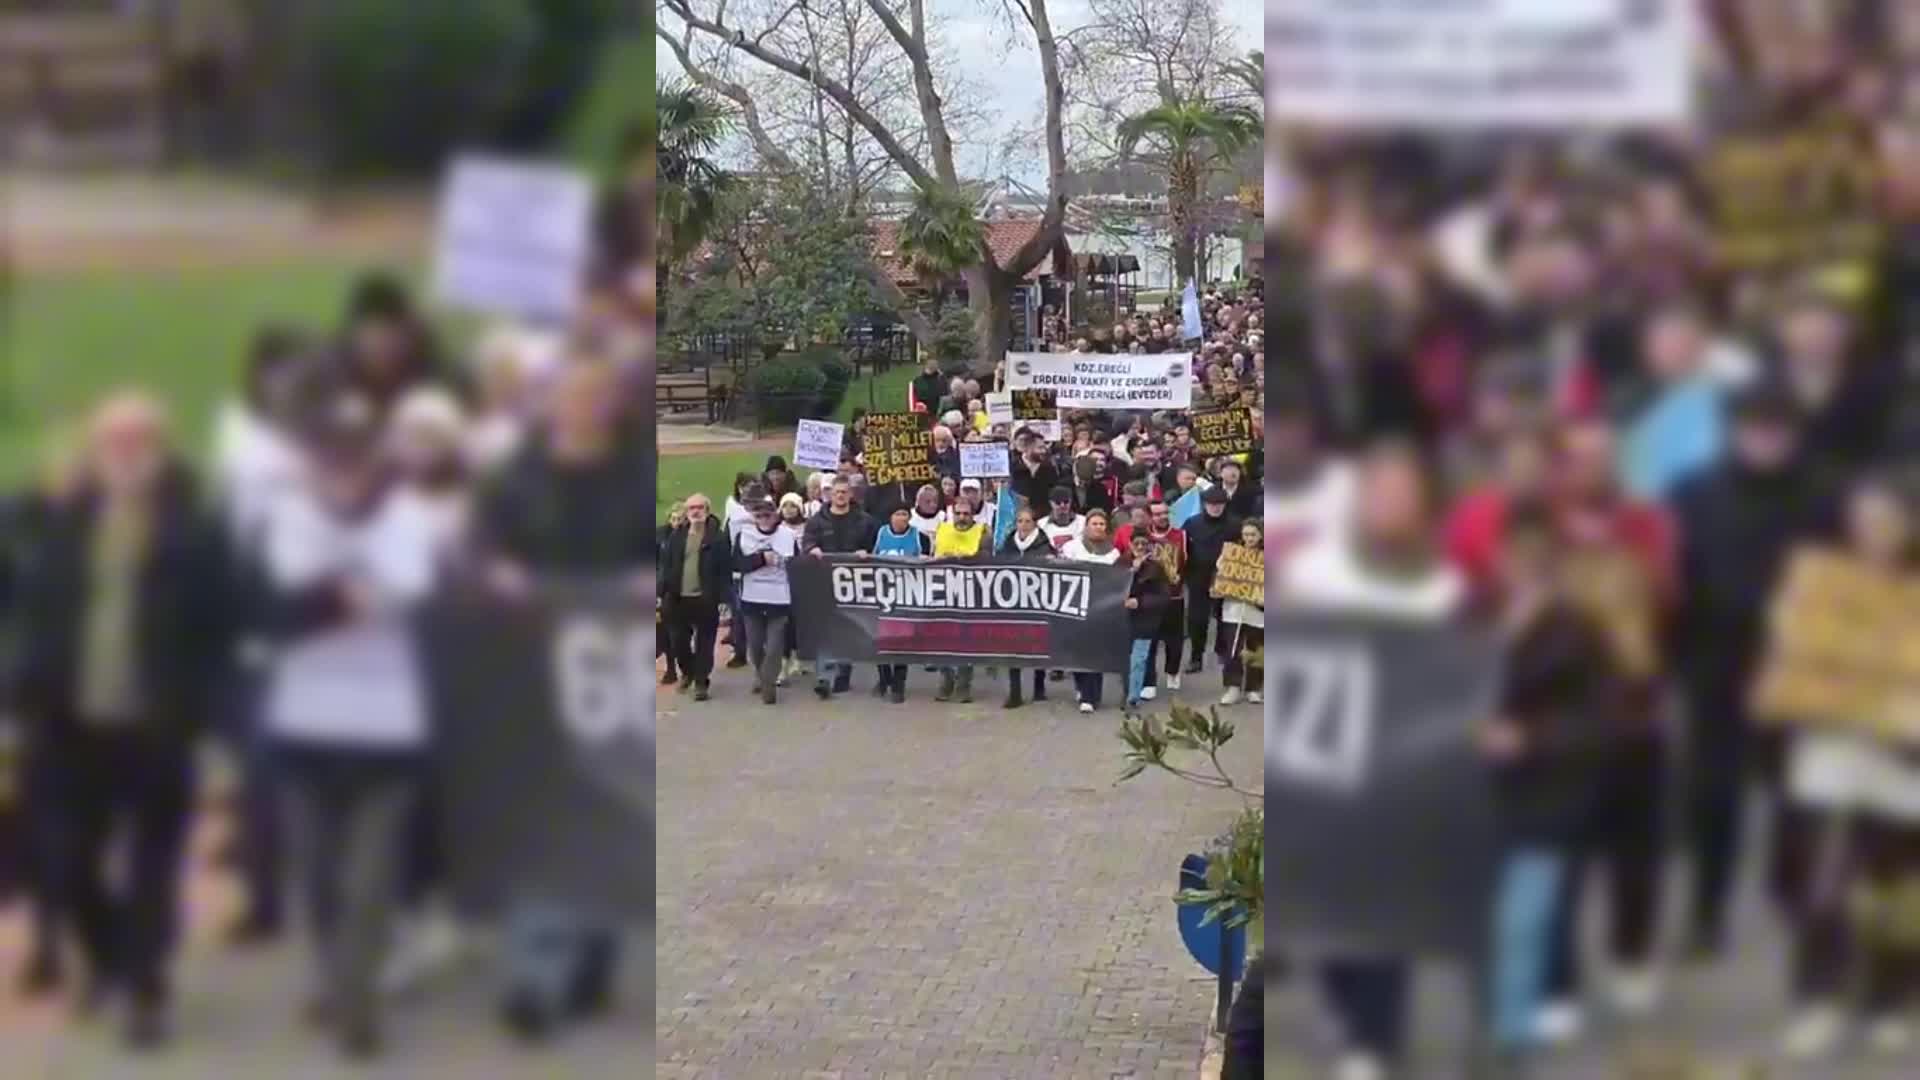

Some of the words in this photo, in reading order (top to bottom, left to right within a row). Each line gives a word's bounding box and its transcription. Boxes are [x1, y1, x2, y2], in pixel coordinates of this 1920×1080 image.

[1033, 374, 1077, 385] ERDEMİR
[1111, 376, 1123, 386] VE
[1125, 374, 1168, 386] ERDEMİR
